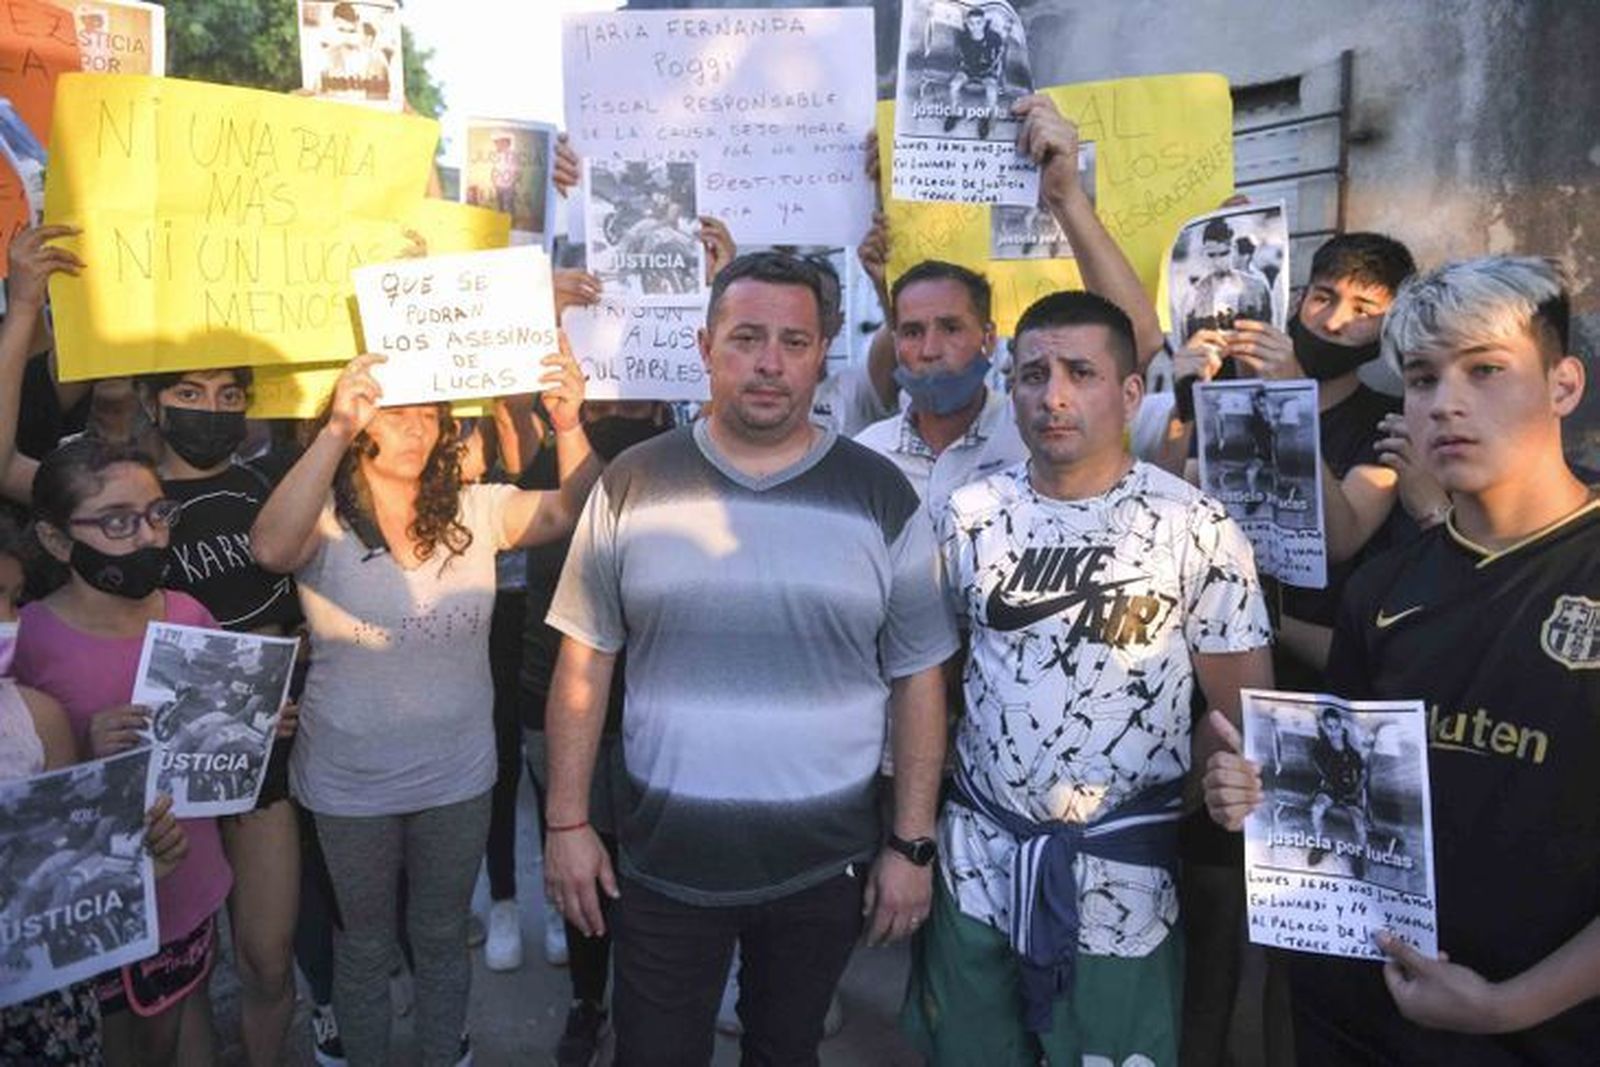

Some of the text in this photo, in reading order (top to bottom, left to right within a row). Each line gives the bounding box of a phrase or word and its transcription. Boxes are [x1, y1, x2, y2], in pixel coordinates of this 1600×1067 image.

[667, 17, 806, 39] FERNANDA
[79, 30, 145, 53] STICIA
[580, 92, 838, 115] FISCAL RESPONSABLE
[966, 106, 993, 119] por
[189, 114, 278, 173] UNA
[292, 126, 376, 177] BALA
[198, 232, 261, 284] UN
[381, 270, 490, 308] QUE SE
[406, 303, 485, 325] PUDRAN
[383, 333, 430, 351] LOS
[653, 325, 699, 350] LOS
[452, 354, 480, 369] DE
[432, 368, 518, 393] LUCAS
[1004, 546, 1117, 593] NIKE
[1064, 594, 1161, 645] AIR
[160, 752, 249, 773] USTICIA
[1267, 827, 1414, 869] justicia por lucas
[1, 889, 124, 945] USTICIA
